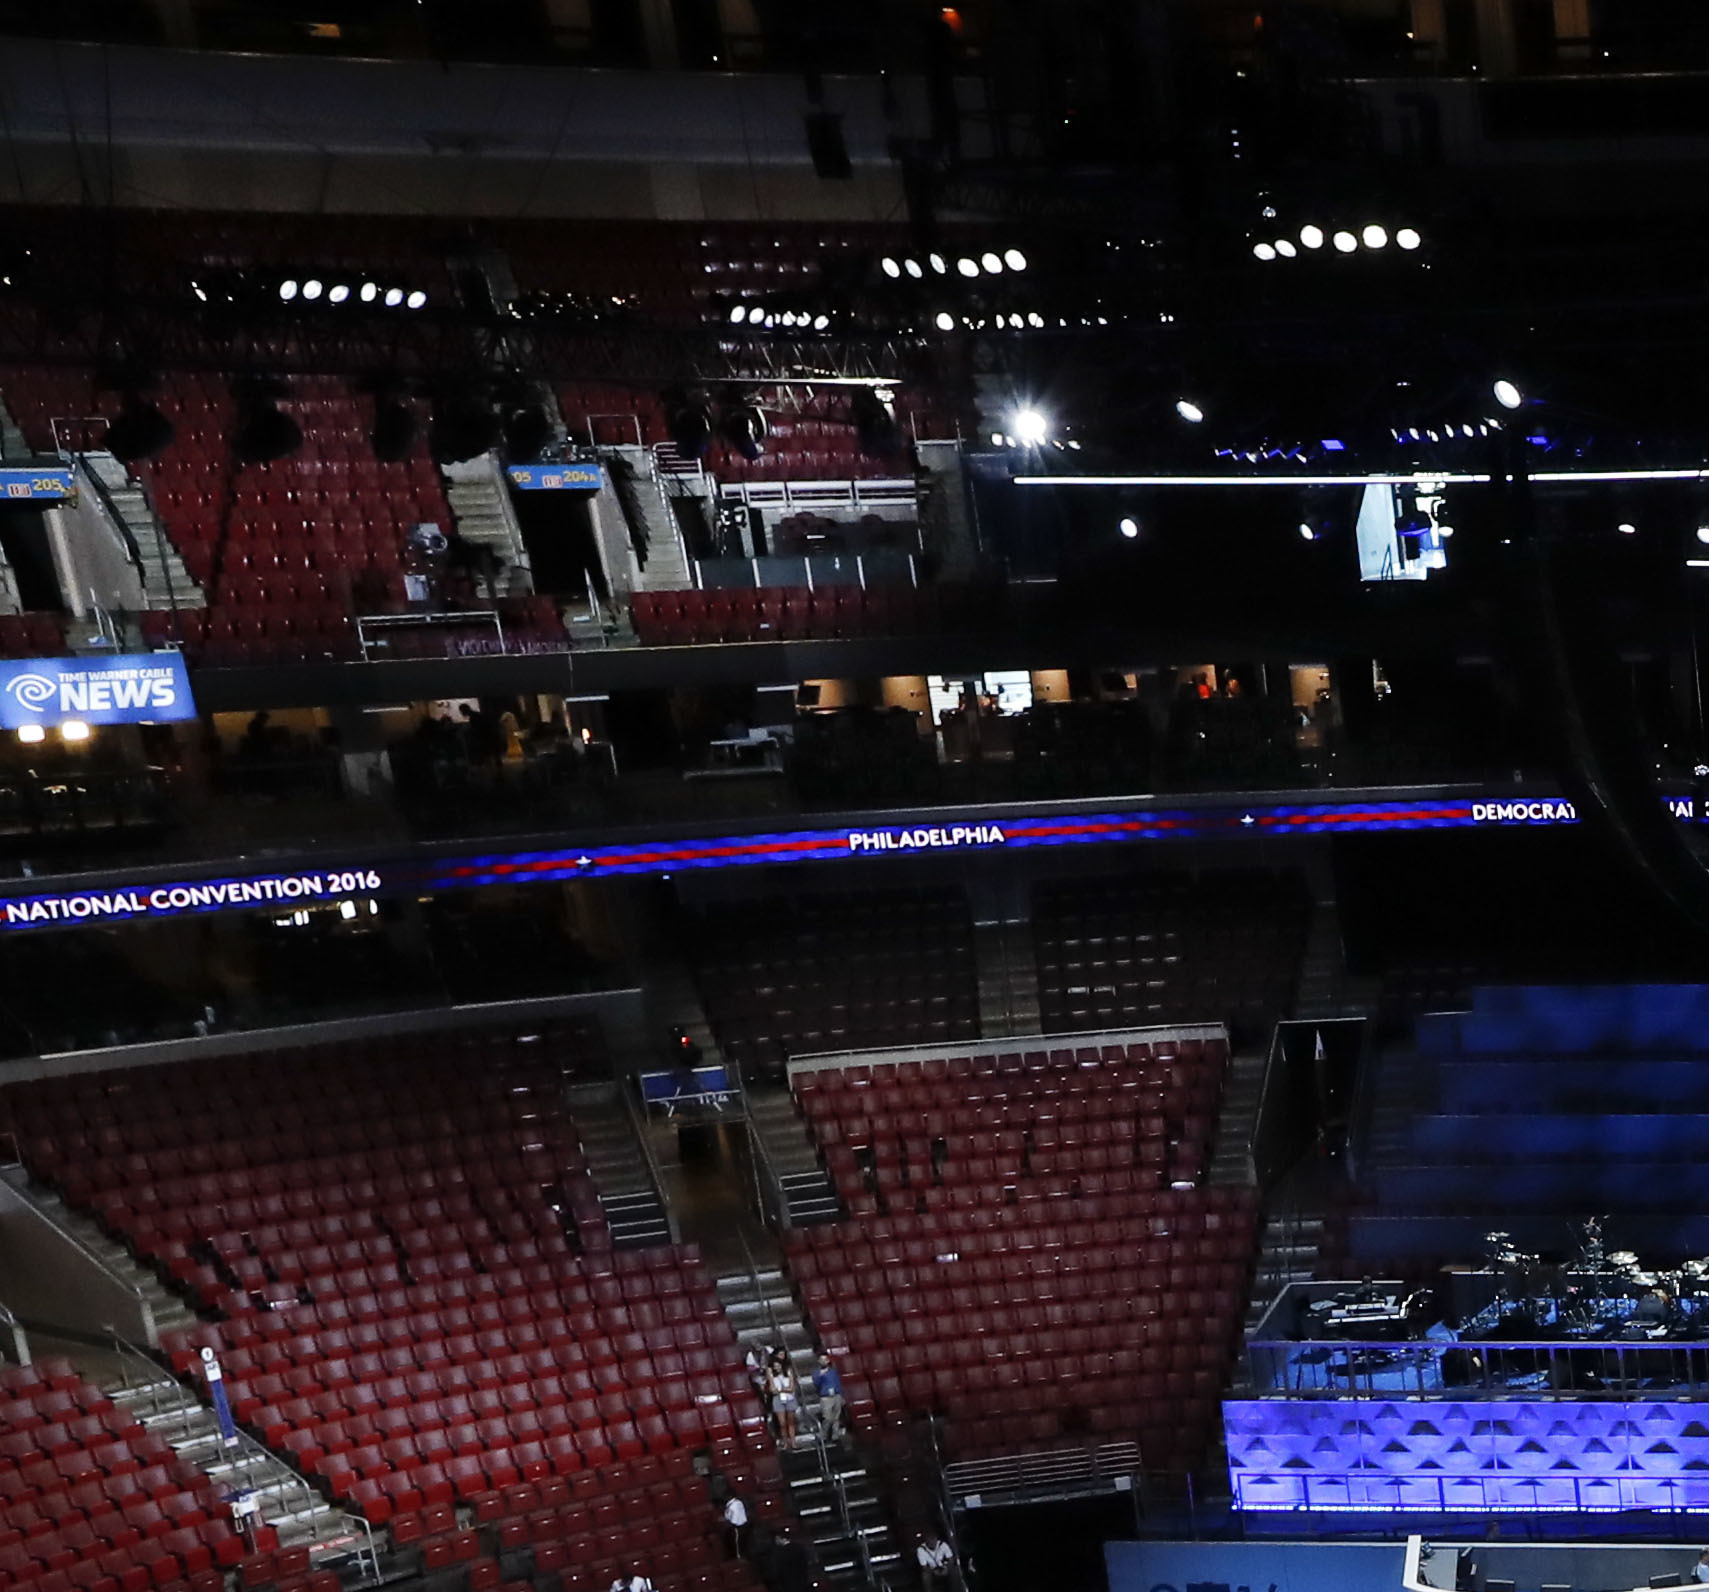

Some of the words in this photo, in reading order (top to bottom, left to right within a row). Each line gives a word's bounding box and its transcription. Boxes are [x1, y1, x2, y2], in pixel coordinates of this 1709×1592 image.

[512, 471, 531, 482] 05
[58, 672, 86, 682] TIME
[88, 669, 138, 681] WARNER
[140, 668, 173, 679] CABLE
[60, 679, 175, 712] NEWS
[1472, 803, 1576, 821] DEMOCRAT
[849, 826, 1004, 851] PHILADELPHIA
[6, 892, 147, 924] NATIONAL
[150, 876, 323, 910] CONVENTION
[327, 870, 381, 894] 2016
